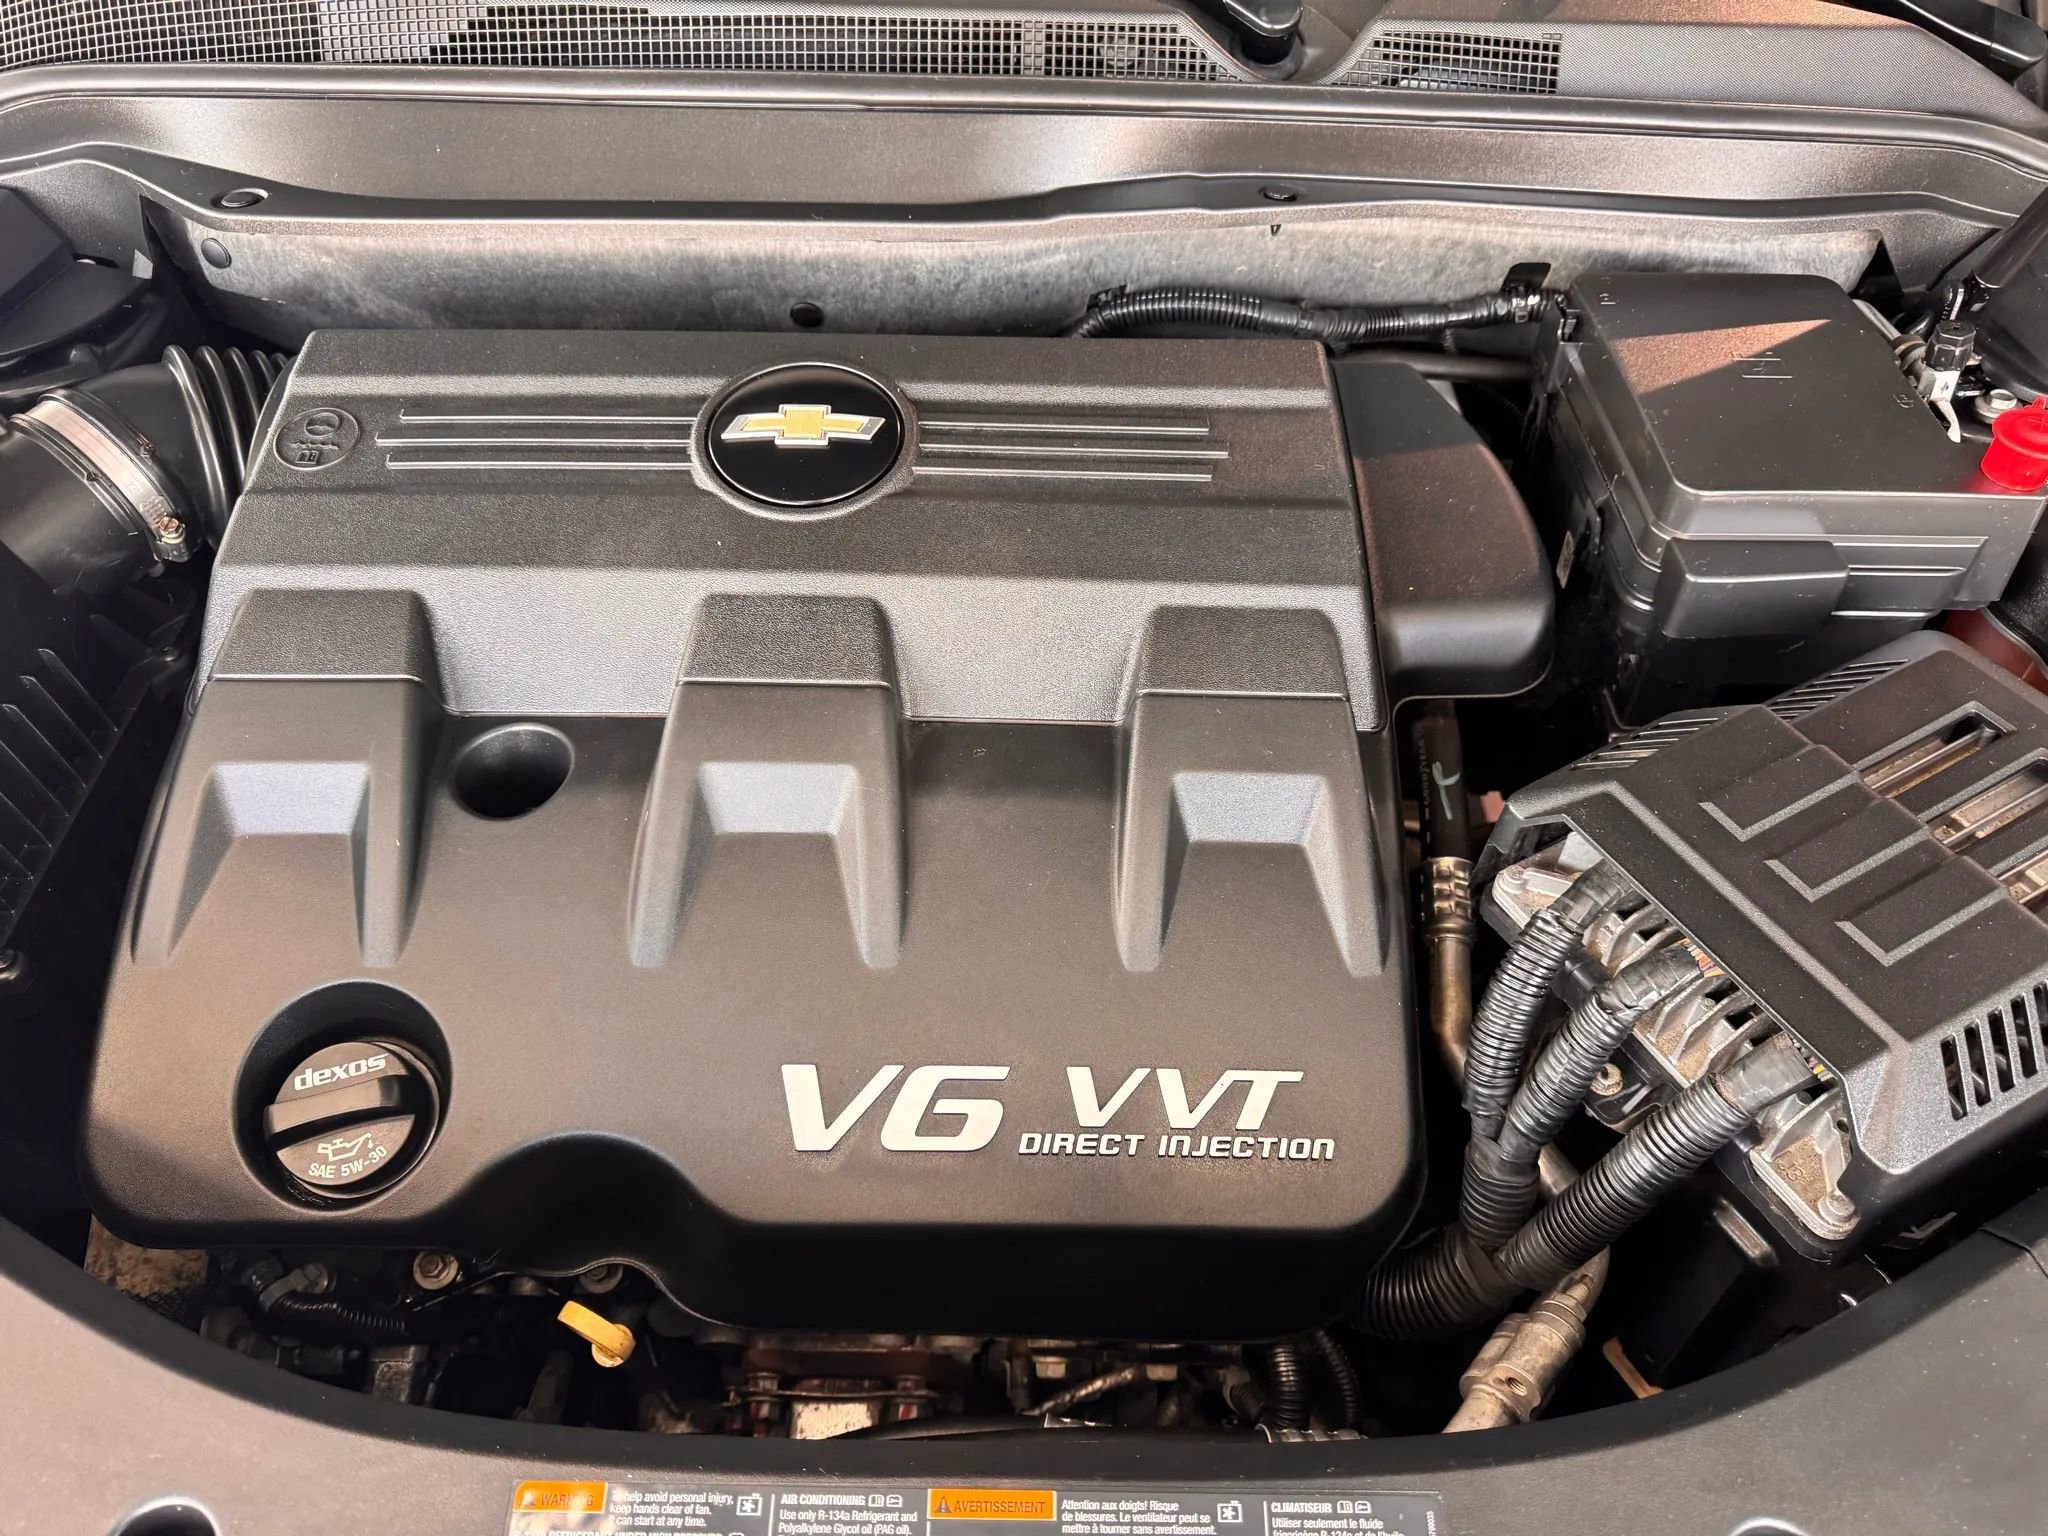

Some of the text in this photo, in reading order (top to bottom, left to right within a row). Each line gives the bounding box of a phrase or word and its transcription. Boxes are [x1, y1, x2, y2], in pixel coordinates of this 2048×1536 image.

[294, 1053, 389, 1091] dexos
[781, 1064, 1304, 1152] V6 VVT
[1018, 1132, 1335, 1160] DIRECT INJECTION
[309, 1146, 388, 1179] SAE 5W-30
[541, 1494, 594, 1507] WARNG
[624, 1491, 643, 1503] help
[644, 1491, 668, 1502] avoid
[669, 1492, 706, 1504] personal
[780, 1494, 866, 1506] AIR CONDITIONING
[609, 1503, 712, 1515] keep hands clear of fan.
[954, 1500, 1046, 1513] AVERTISSEMENT
[1061, 1500, 1179, 1513] Attention aux doigts! Risque
[1271, 1502, 1332, 1513] CLIMATISEUR
[616, 1516, 632, 1526] can
[634, 1516, 654, 1526] start
[656, 1516, 666, 1526] at
[667, 1517, 683, 1528] any
[684, 1516, 707, 1527] time.
[780, 1509, 918, 1523] Use only R-134a Refrigerant and
[1062, 1511, 1211, 1524] de blessures. Le ventilateur peut se
[778, 1522, 912, 1536] Polyalkylene Glycol oil (PAG oil).
[1061, 1523, 1217, 1535] mettre à tourner sans avertissement.
[1271, 1517, 1384, 1529] Utiliser seulement le fluide
